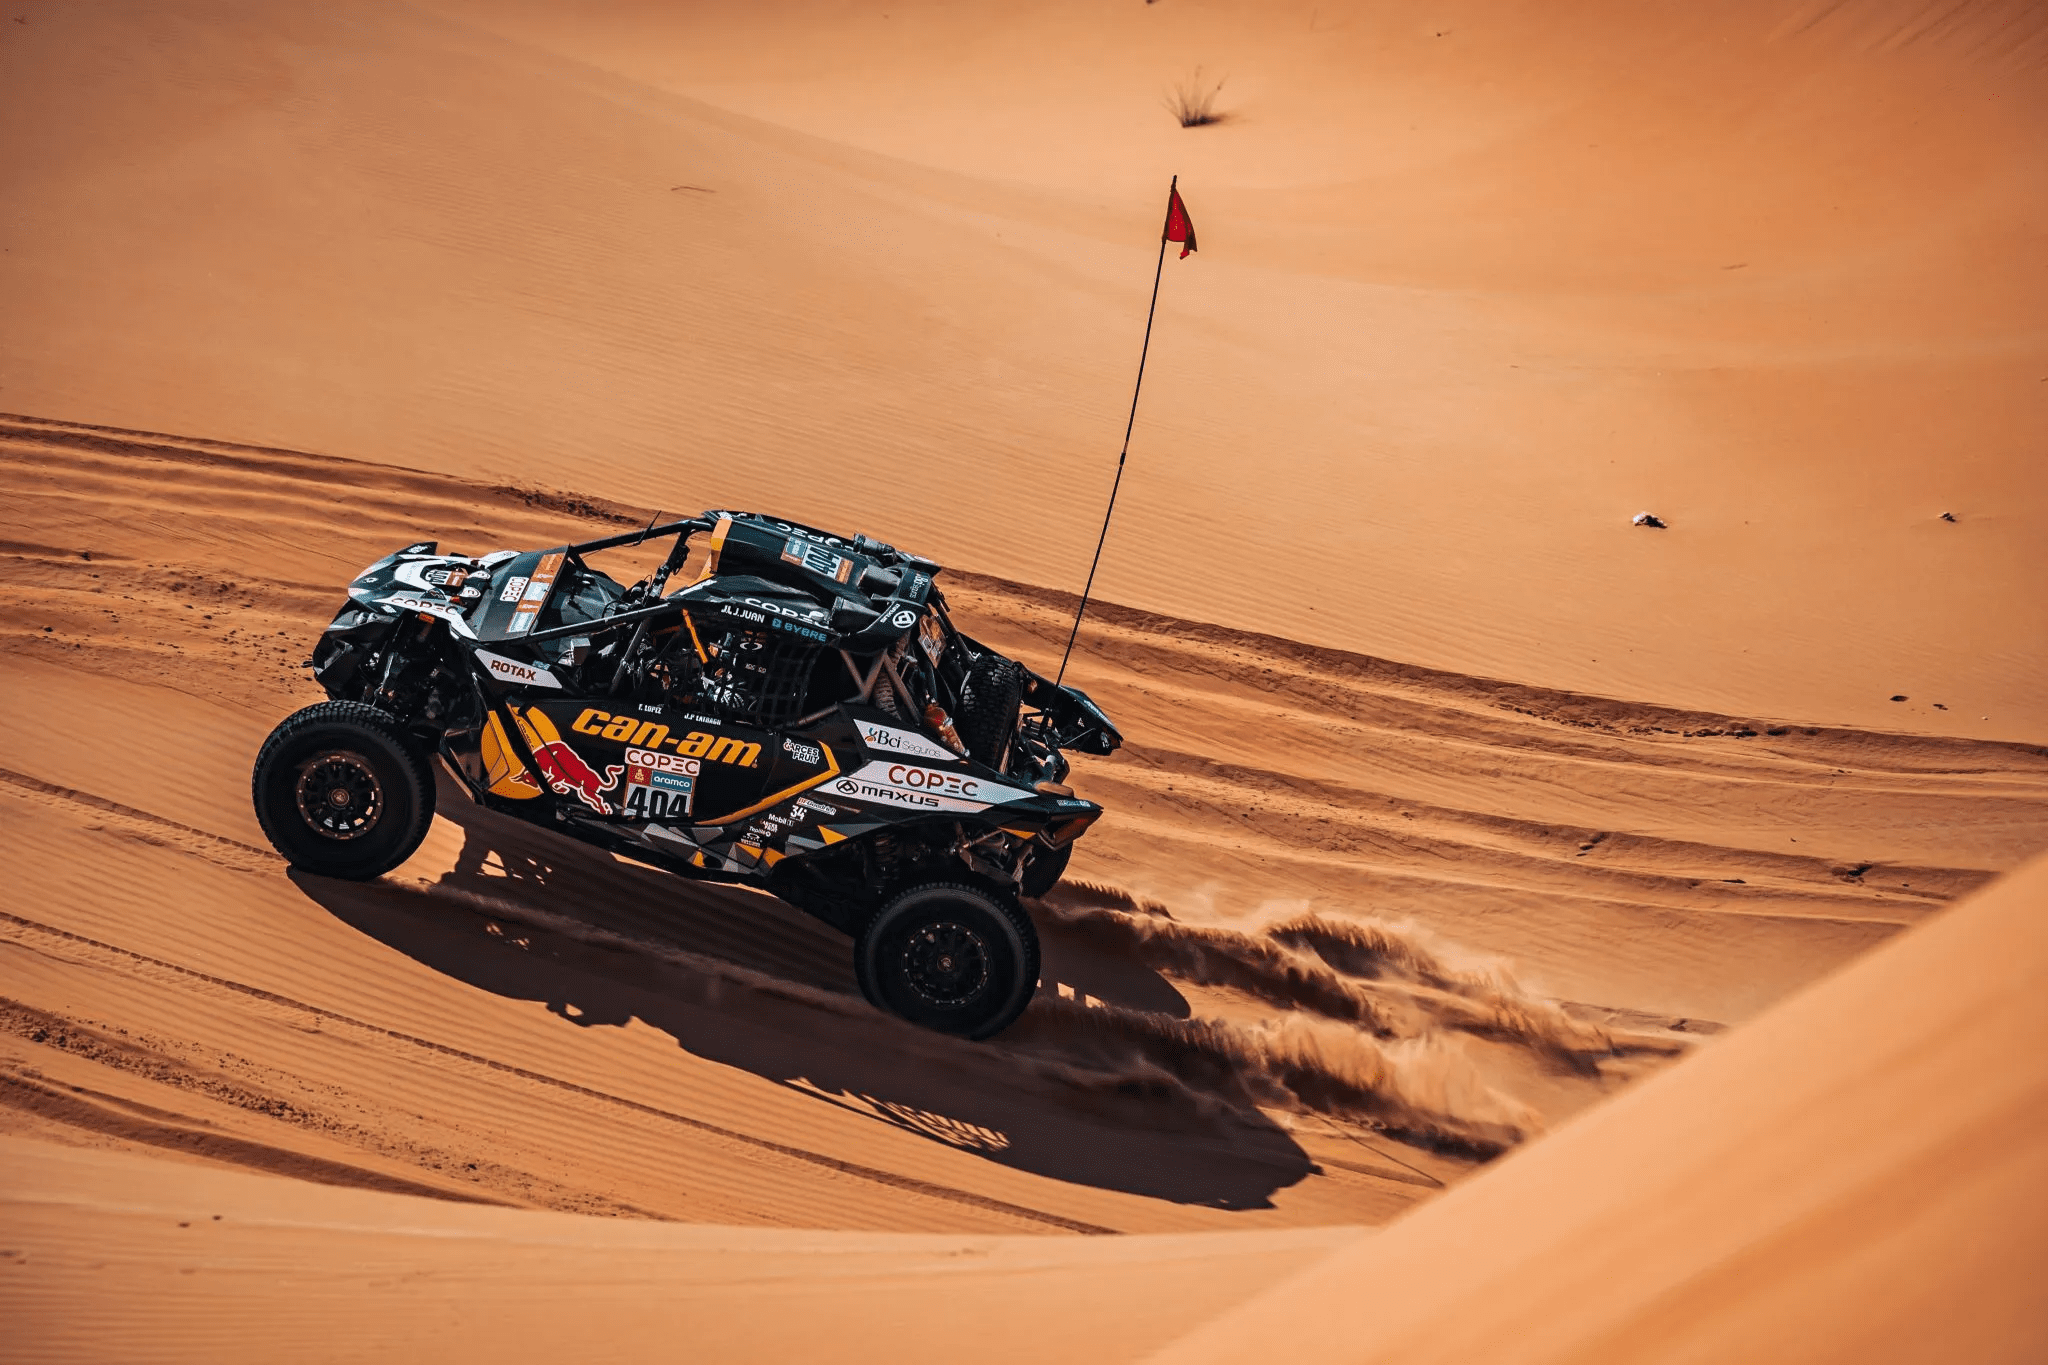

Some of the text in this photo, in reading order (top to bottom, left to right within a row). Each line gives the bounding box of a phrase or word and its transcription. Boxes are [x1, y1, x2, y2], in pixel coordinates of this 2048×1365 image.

[776, 522, 854, 551] OPEC
[804, 546, 840, 578] 404
[784, 623, 827, 642] BYBRE
[491, 660, 537, 681] ROTAX
[644, 704, 662, 715] LOPEZ
[572, 708, 762, 767] can-am
[877, 731, 941, 758] Bci Seguros
[627, 749, 699, 775] COPEC
[792, 752, 819, 765] FRUIT
[653, 775, 691, 788] aramco
[888, 765, 979, 797] COPEC
[627, 786, 690, 818] 404
[861, 784, 940, 808] MAXUS
[768, 814, 787, 825] Mobil
